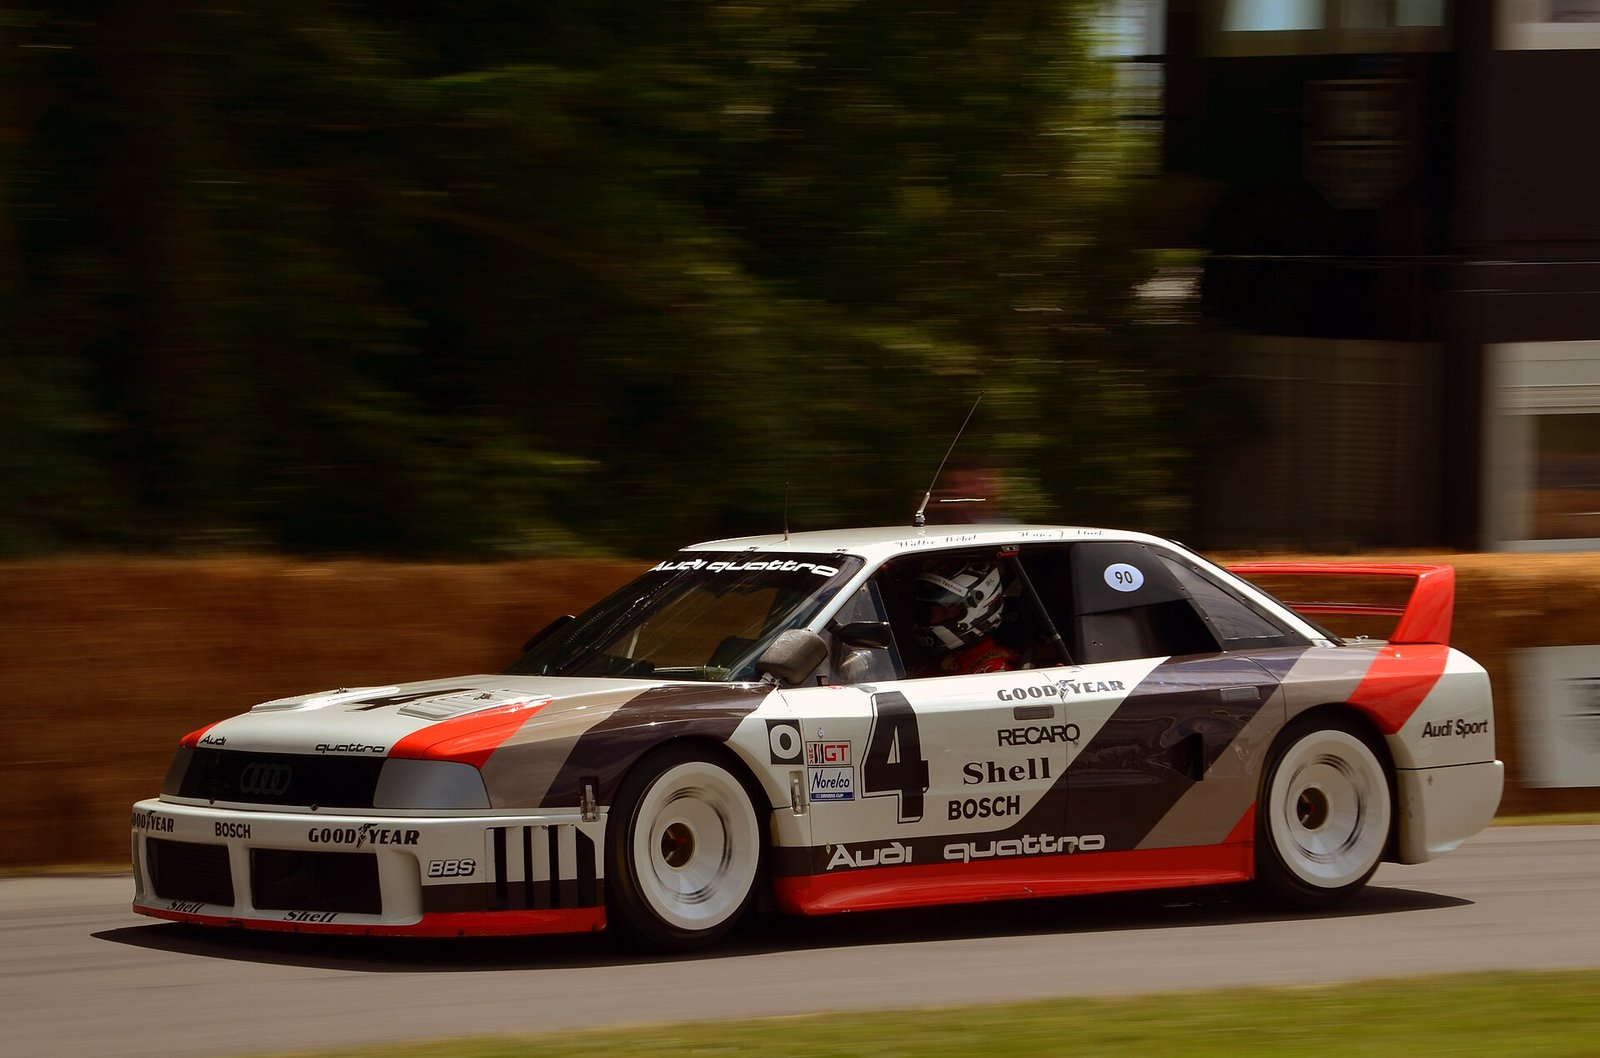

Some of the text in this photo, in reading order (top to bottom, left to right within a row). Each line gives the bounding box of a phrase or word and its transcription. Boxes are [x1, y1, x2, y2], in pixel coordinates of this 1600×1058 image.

[649, 558, 839, 577] Audi quattro
[1114, 569, 1133, 585] 90
[998, 723, 1081, 747] RECARO
[1422, 718, 1488, 739] Audi Sport
[199, 734, 386, 753] Audi quattro
[824, 744, 849, 762] GT
[860, 691, 930, 824] 4
[811, 769, 850, 792] Norelco
[963, 757, 1052, 786] Shell
[948, 795, 1020, 821] BOSCH
[215, 821, 251, 840] BOSCH
[308, 824, 420, 848] GOODYEAR
[826, 833, 1106, 871] Audi quattro
[427, 858, 476, 878] BBS
[167, 900, 205, 914] Shell
[282, 910, 339, 923] Shell
